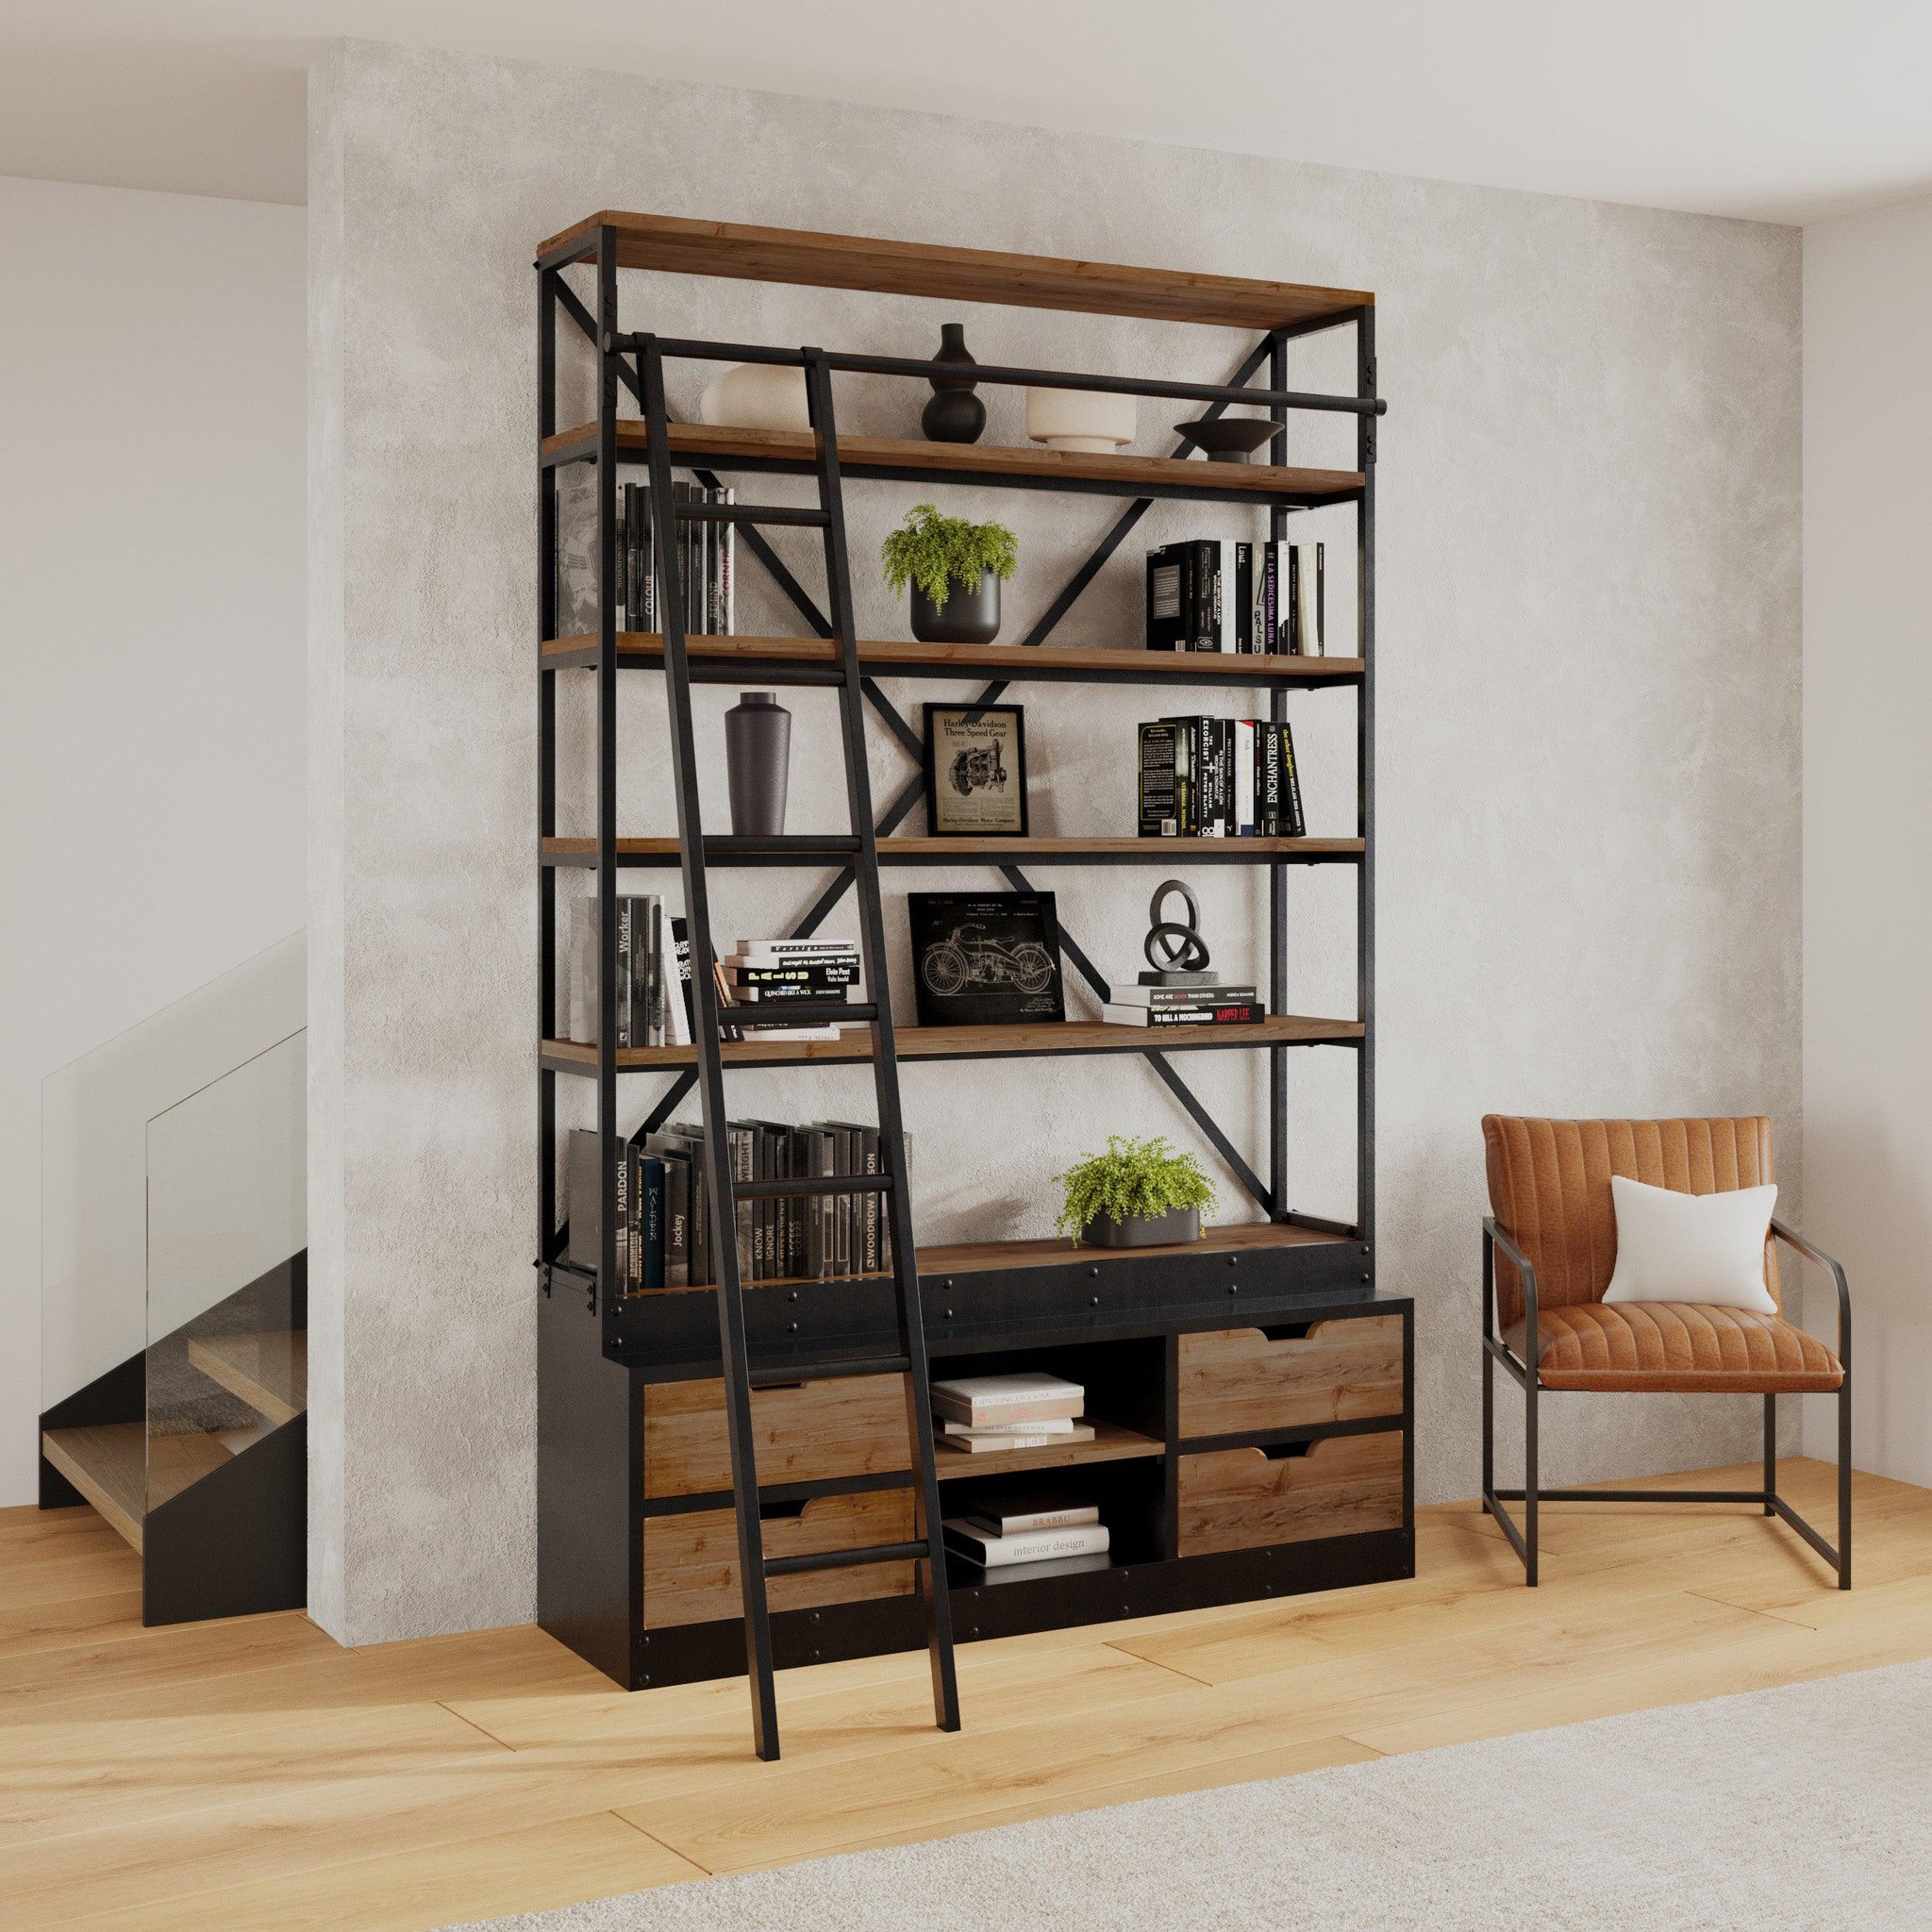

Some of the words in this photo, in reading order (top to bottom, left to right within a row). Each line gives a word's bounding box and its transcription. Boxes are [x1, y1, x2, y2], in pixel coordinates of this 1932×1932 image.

[1268, 563, 1274, 573] LA
[709, 582, 718, 618] REMIND
[967, 728, 989, 738] Speed
[989, 728, 1007, 737] Gear
[1267, 733, 1277, 804] ENCHANTRESS
[619, 911, 628, 953] Worker
[839, 967, 851, 975] Post
[1155, 1014, 1161, 1023] TO
[1162, 1013, 1174, 1022] KILL
[1174, 1013, 1178, 1022] A
[1179, 1012, 1213, 1022] MOCKINGBIRD
[1216, 1008, 1239, 1022] HARPER
[1239, 1008, 1251, 1020] LEE
[741, 1141, 750, 1182] WEIGHT
[618, 1160, 626, 1211] PARDON
[673, 1214, 685, 1247] Jockey
[755, 1227, 763, 1259] KNOW
[766, 1224, 774, 1260] IGNORE
[867, 1200, 875, 1259] WOODROW
[629, 1231, 639, 1277] ARCHIMEDES
[1033, 1515, 1071, 1525] BRABBU
[1013, 1543, 1051, 1556] interior
[1053, 1540, 1085, 1551] design
